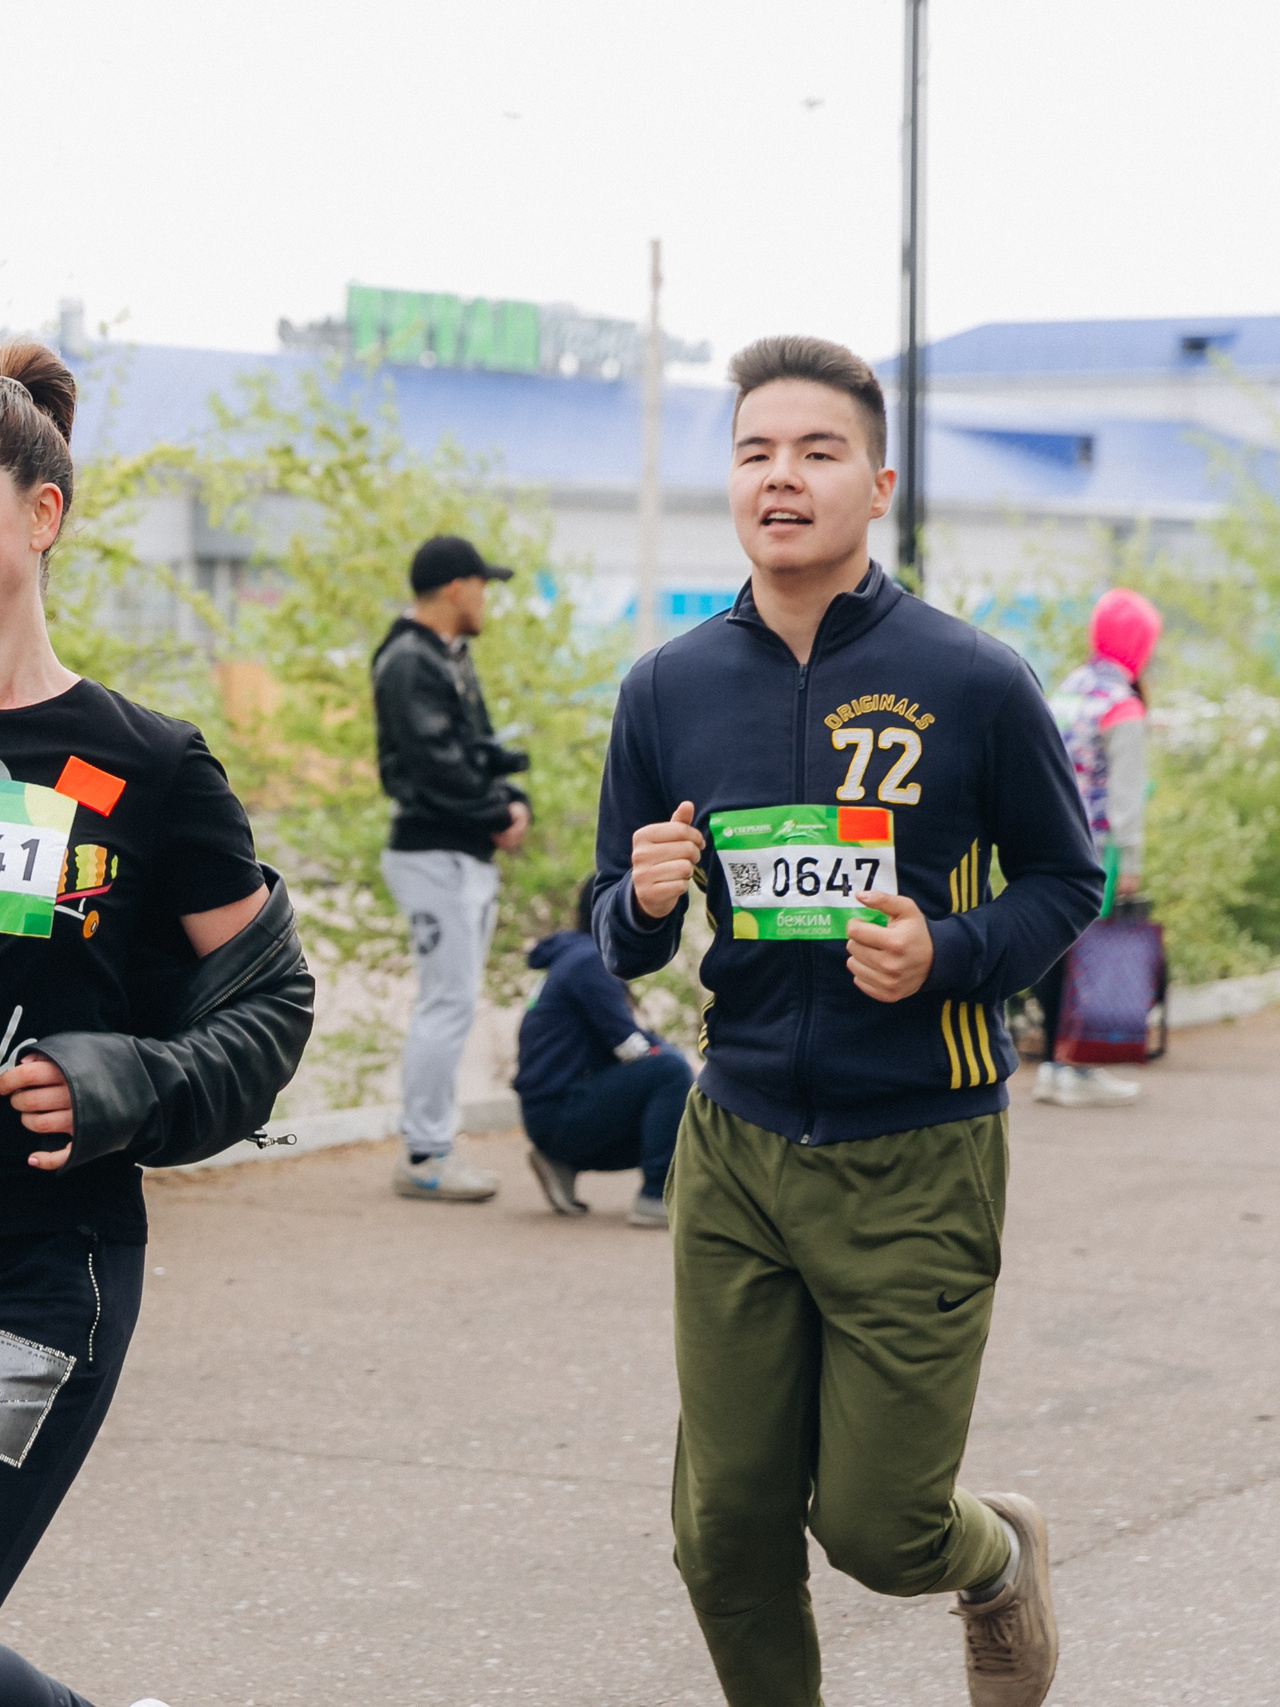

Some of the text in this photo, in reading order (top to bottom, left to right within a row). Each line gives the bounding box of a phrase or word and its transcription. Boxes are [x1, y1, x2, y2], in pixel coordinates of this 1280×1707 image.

[823, 693, 936, 731] ORIGINALS
[831, 726, 922, 806] 72
[773, 856, 880, 897] 0647
[776, 911, 831, 927] бежим
